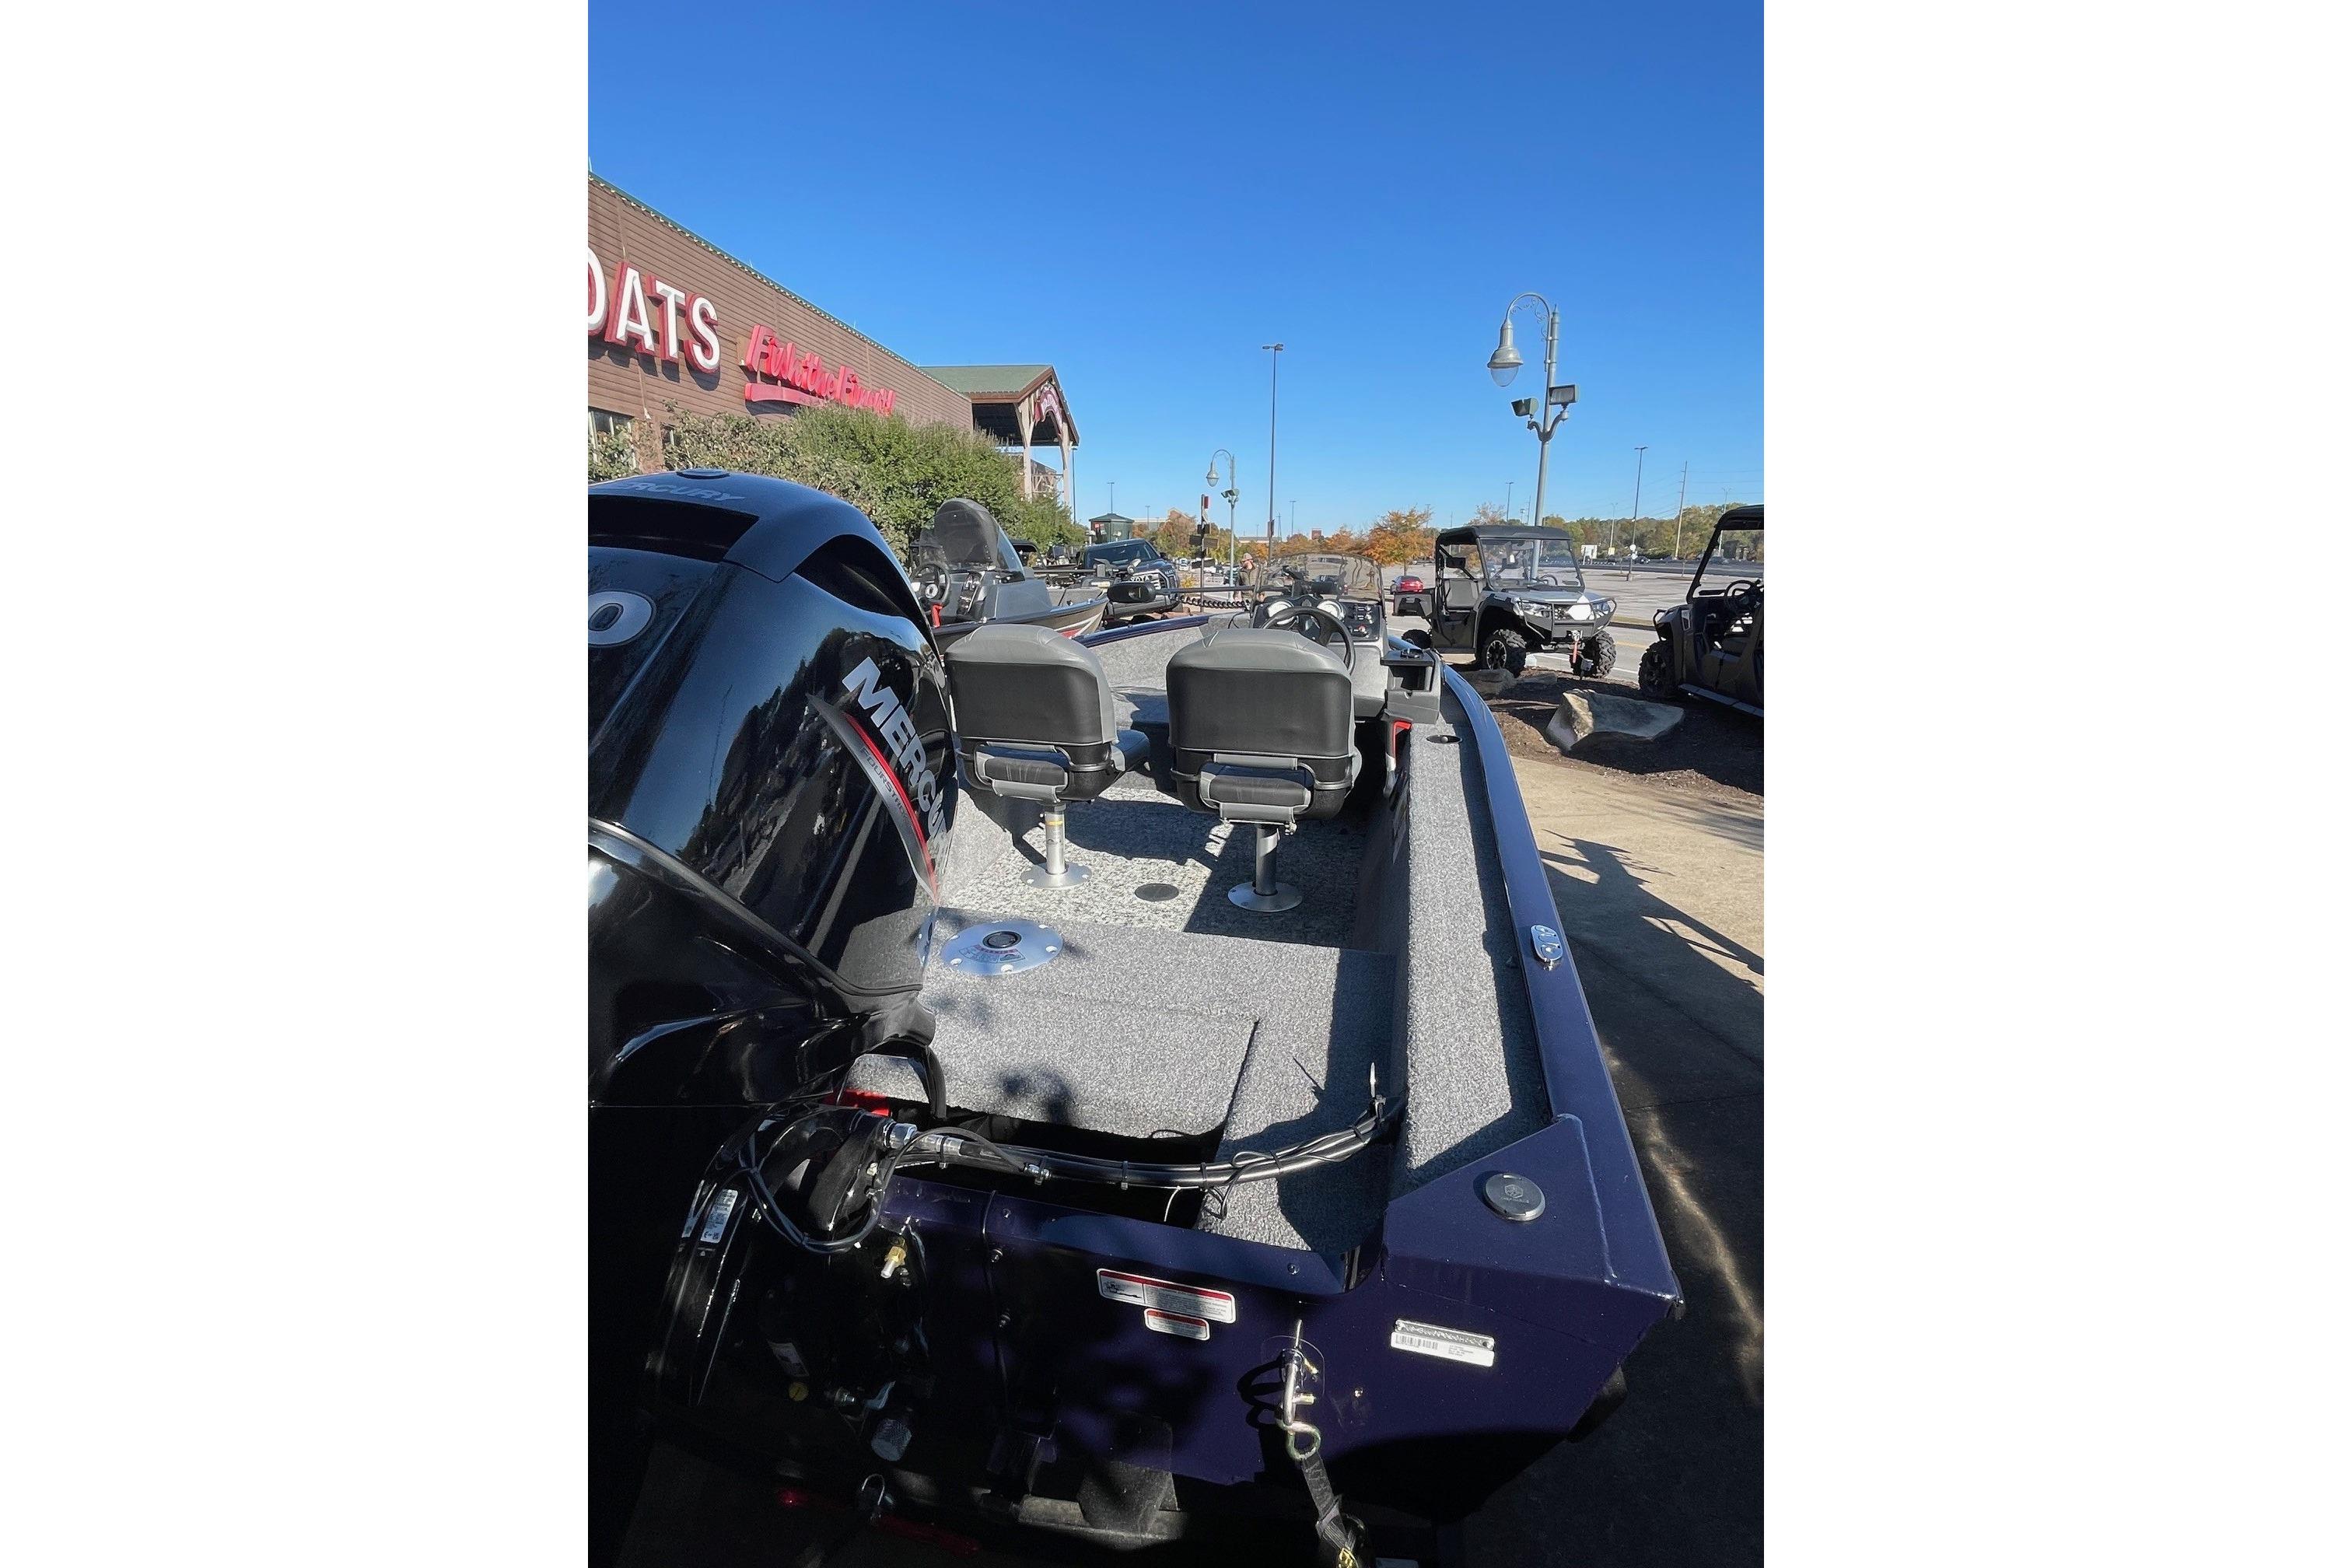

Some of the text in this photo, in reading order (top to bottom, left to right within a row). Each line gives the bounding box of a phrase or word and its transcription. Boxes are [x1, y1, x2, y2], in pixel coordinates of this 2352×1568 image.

[612, 481, 746, 502] ERCURY
[842, 656, 948, 854] MERCU
[859, 746, 908, 817] FOURSTR
